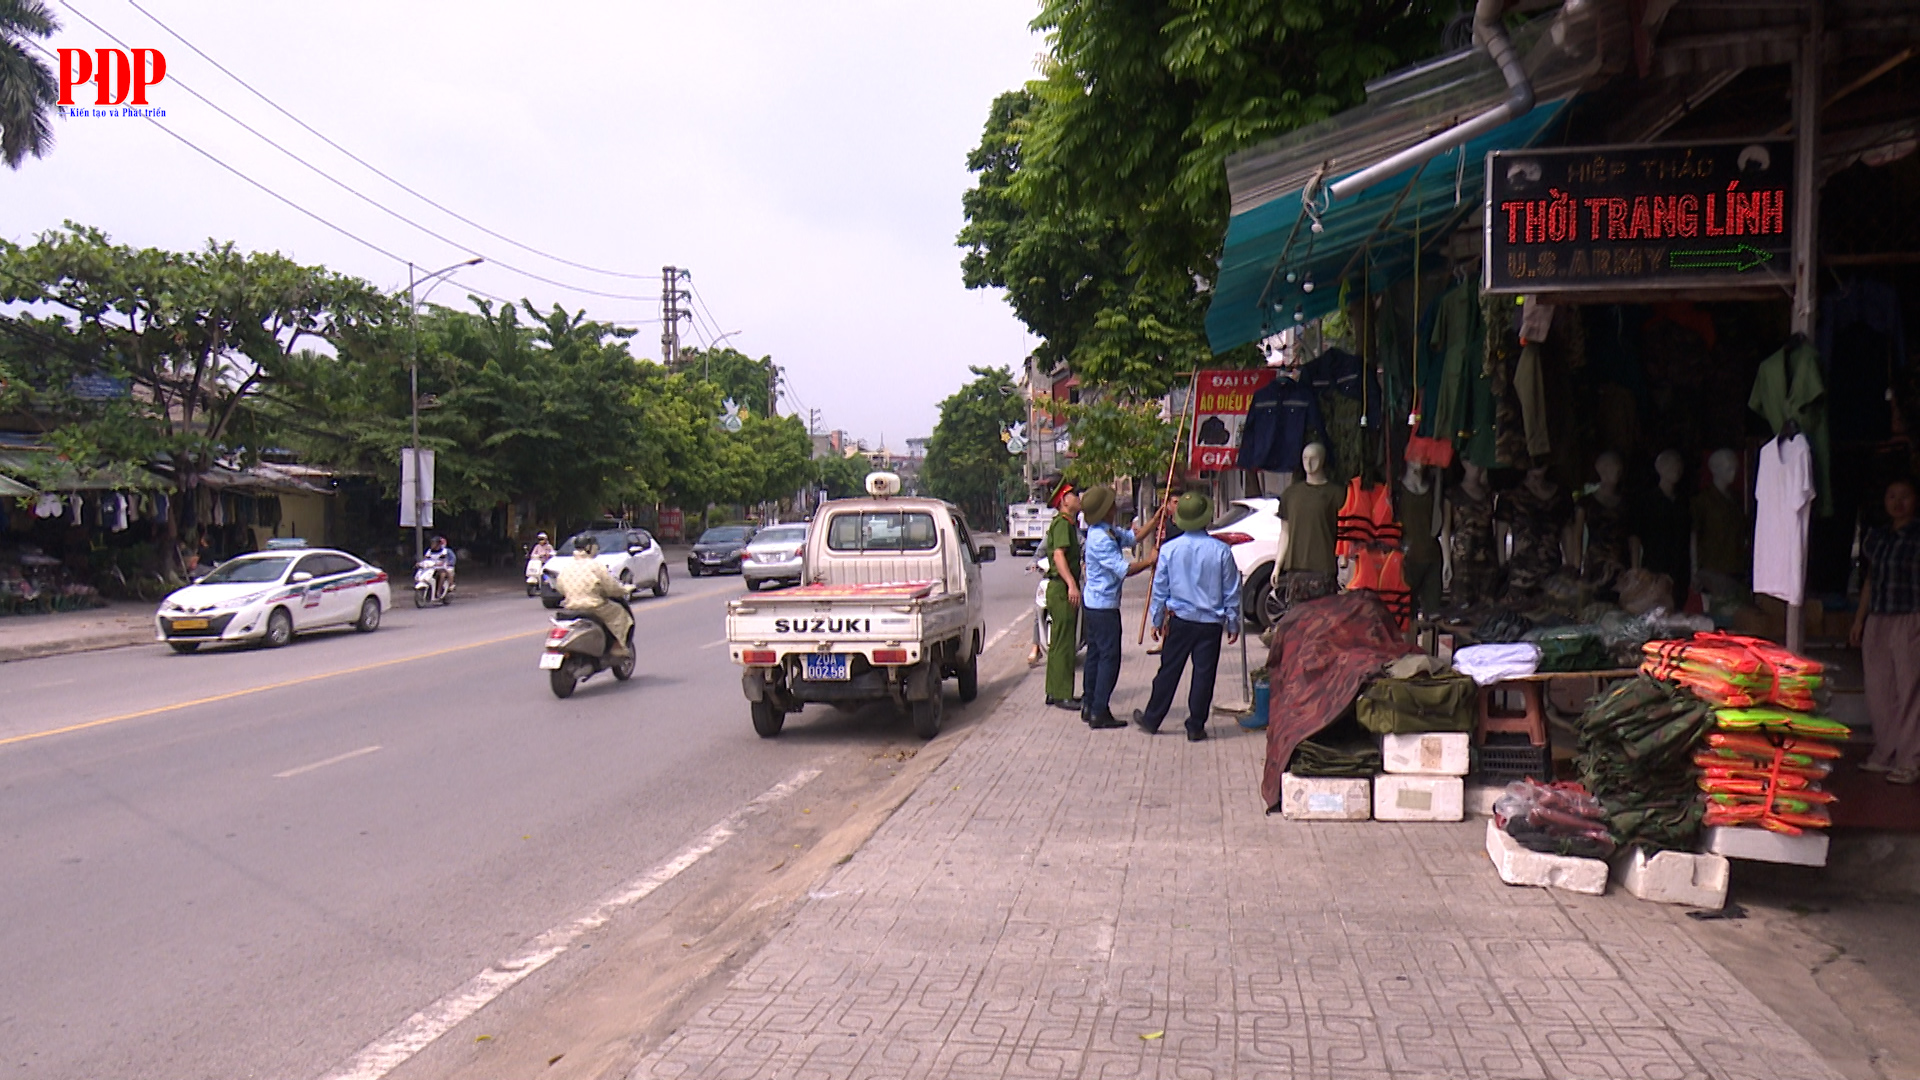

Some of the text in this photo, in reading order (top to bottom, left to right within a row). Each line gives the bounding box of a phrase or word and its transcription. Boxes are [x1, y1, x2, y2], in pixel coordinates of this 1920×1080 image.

[1501, 179, 1784, 243] THỜI TRANG LÍNH
[1202, 449, 1232, 465] GIÁ
[775, 618, 871, 633] SUZUKI
